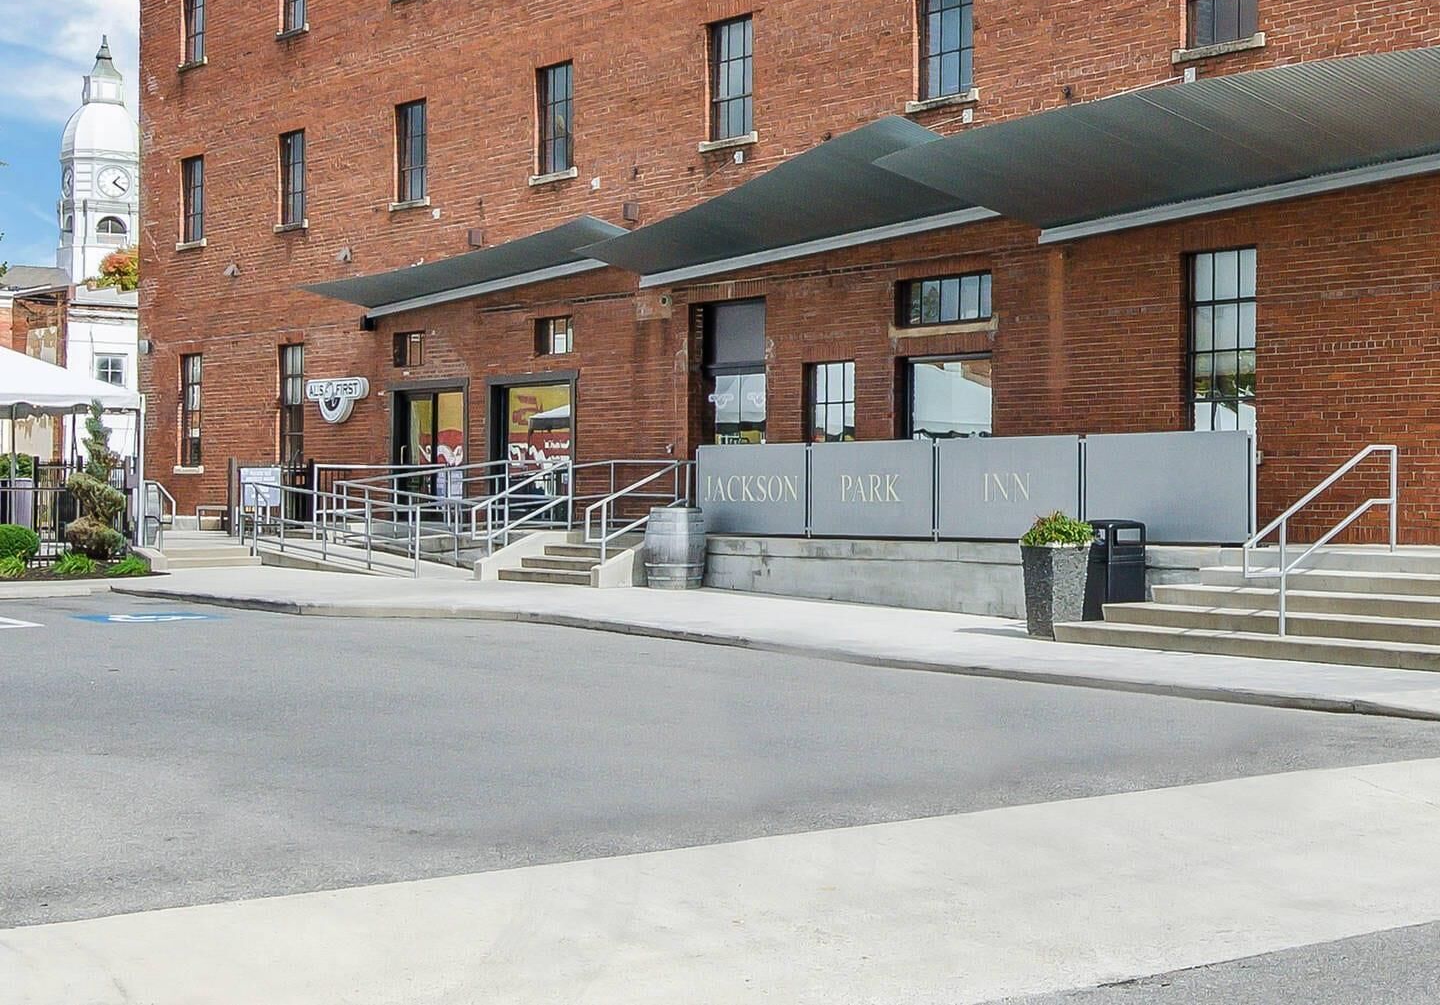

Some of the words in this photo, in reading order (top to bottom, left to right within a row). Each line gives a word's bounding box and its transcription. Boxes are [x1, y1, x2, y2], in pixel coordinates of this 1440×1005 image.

[335, 382, 358, 396] FIRST
[704, 474, 799, 502] JACKSON
[840, 474, 900, 502] PARK
[983, 472, 1031, 502] INN
